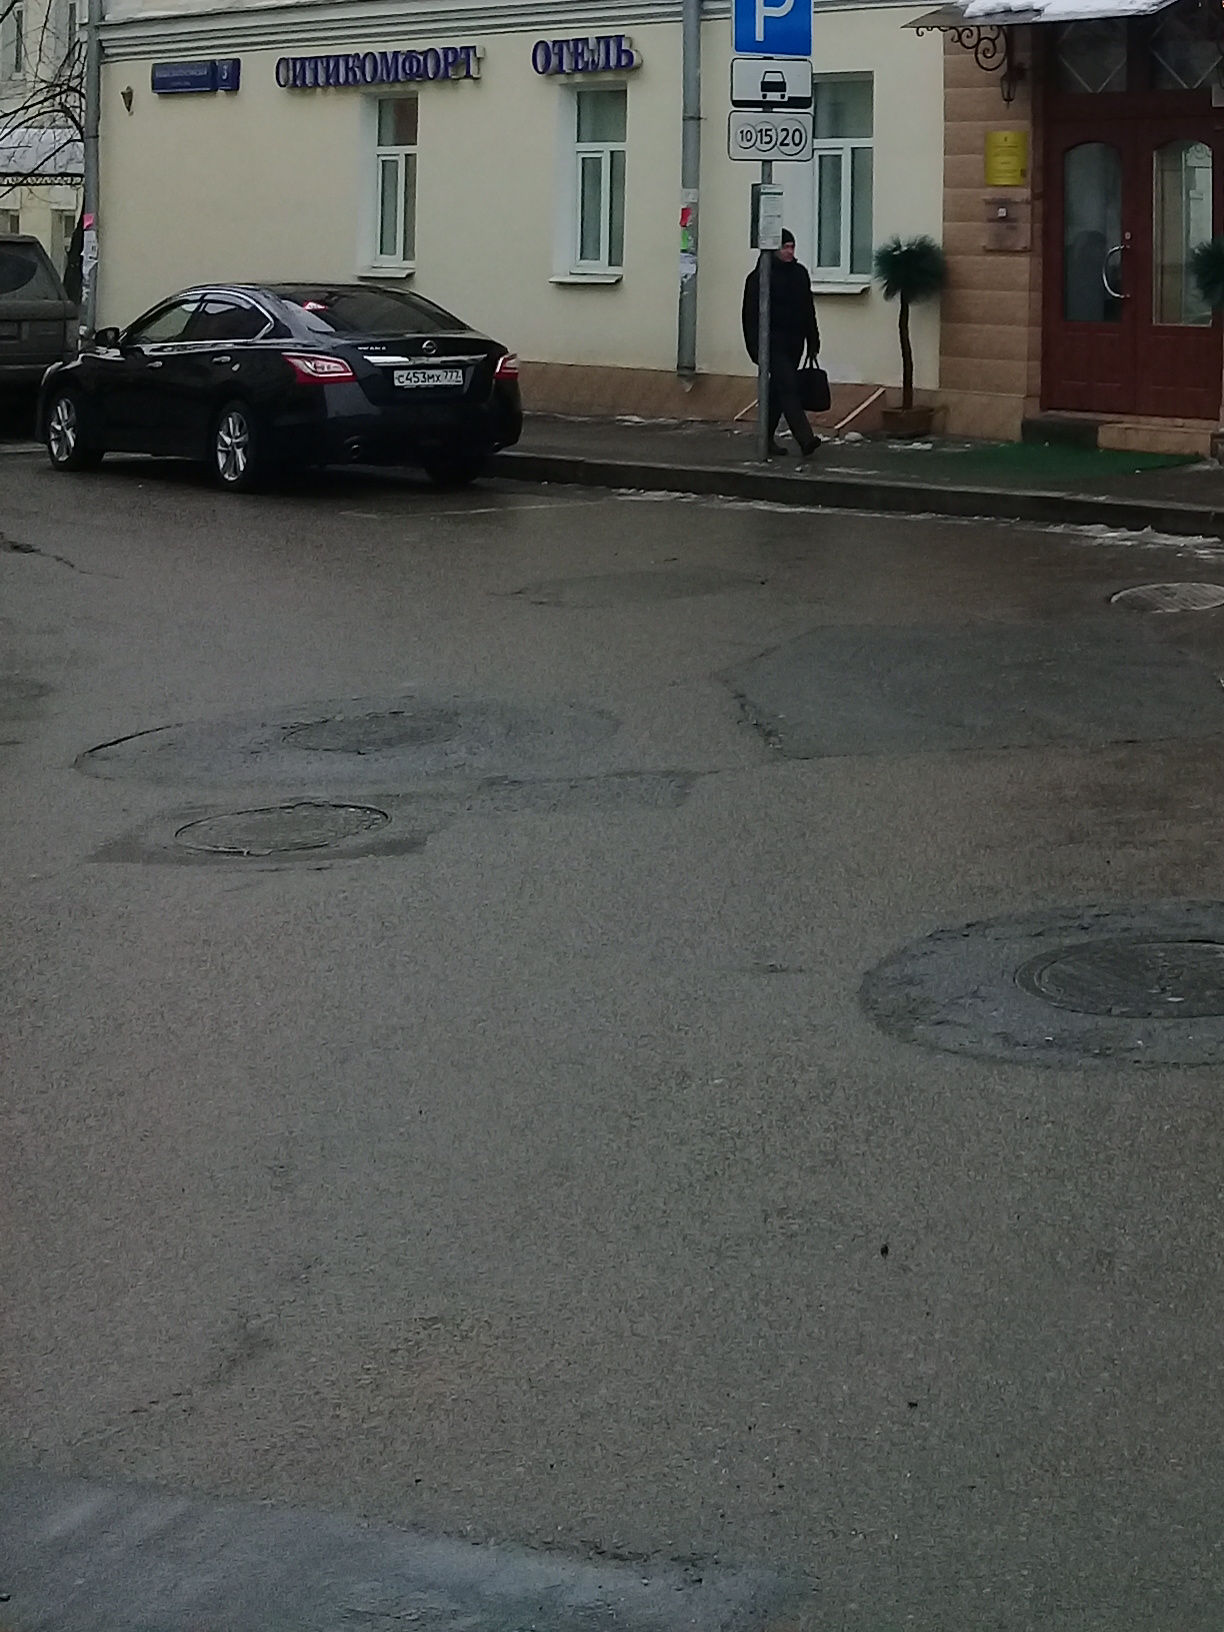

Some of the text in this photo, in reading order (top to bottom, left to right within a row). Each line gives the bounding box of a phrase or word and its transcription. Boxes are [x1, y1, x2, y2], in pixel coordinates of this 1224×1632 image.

[275, 34, 640, 88] СИТИКОМФОРТ ОТЕЛЬ
[739, 127, 803, 147] 10 15 20
